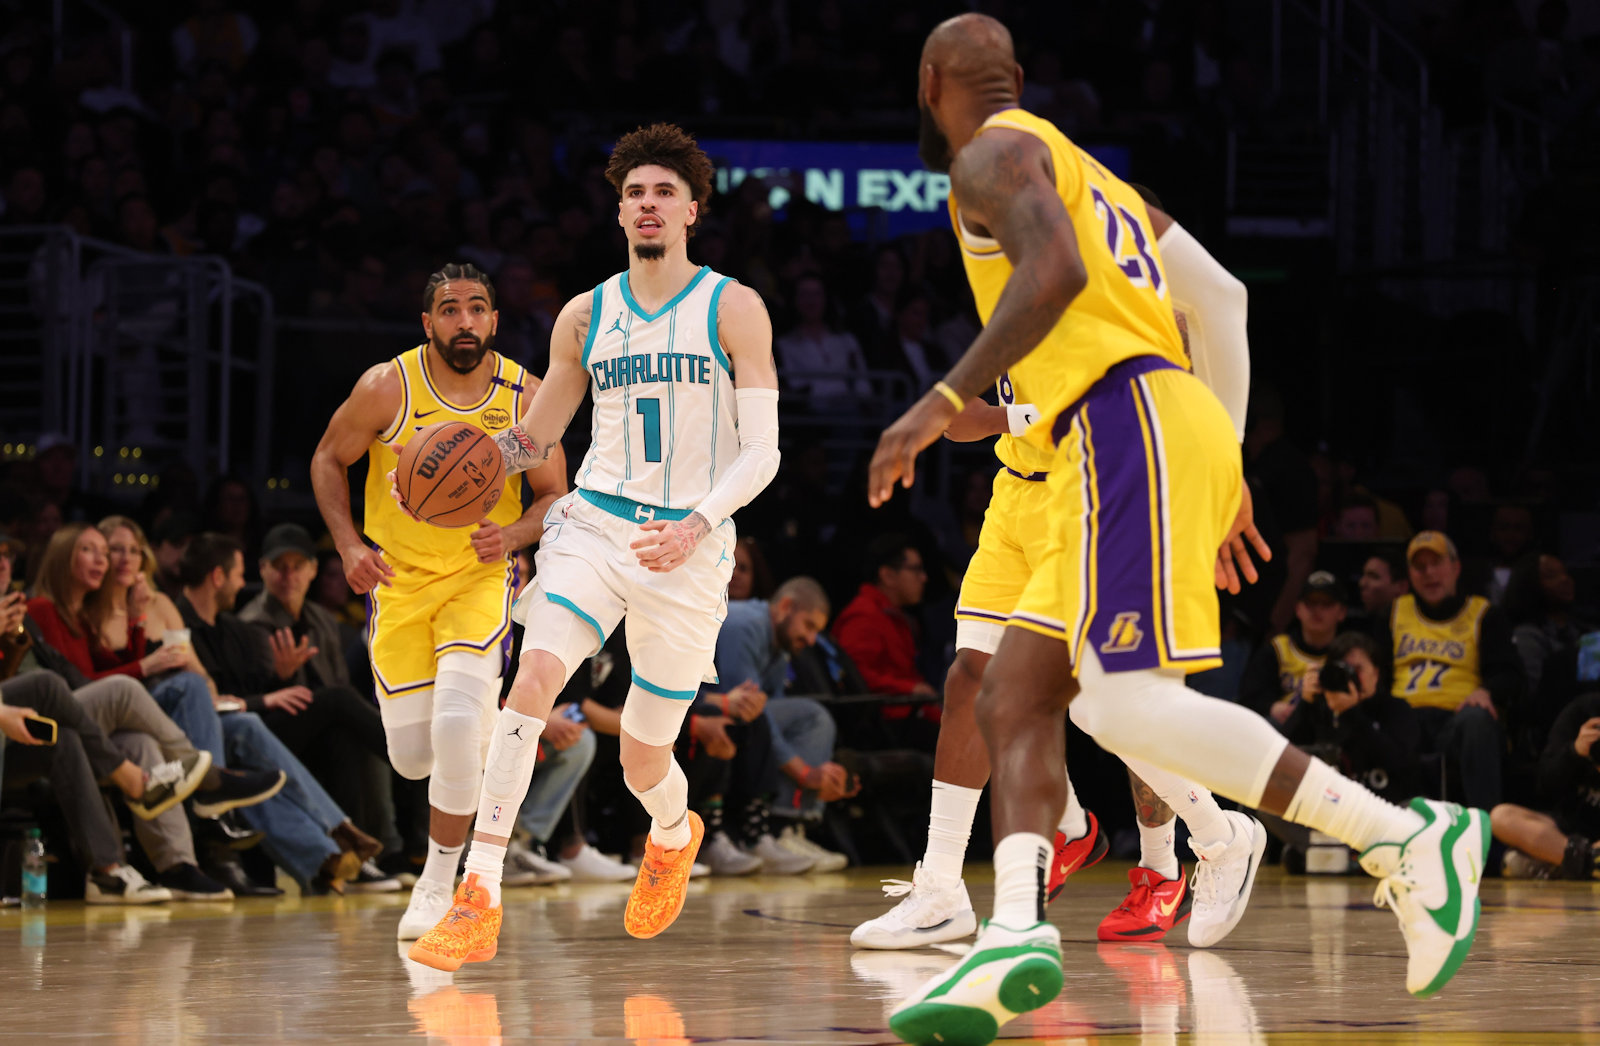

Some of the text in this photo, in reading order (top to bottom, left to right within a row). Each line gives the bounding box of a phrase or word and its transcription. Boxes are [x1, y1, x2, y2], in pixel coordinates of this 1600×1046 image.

[591, 352, 711, 391] CHARLOTTE
[483, 413, 509, 424] bibigo
[636, 398, 662, 463] 1
[416, 427, 475, 480] Wilson
[1396, 634, 1467, 660] LAKERS
[1405, 659, 1452, 693] 77
